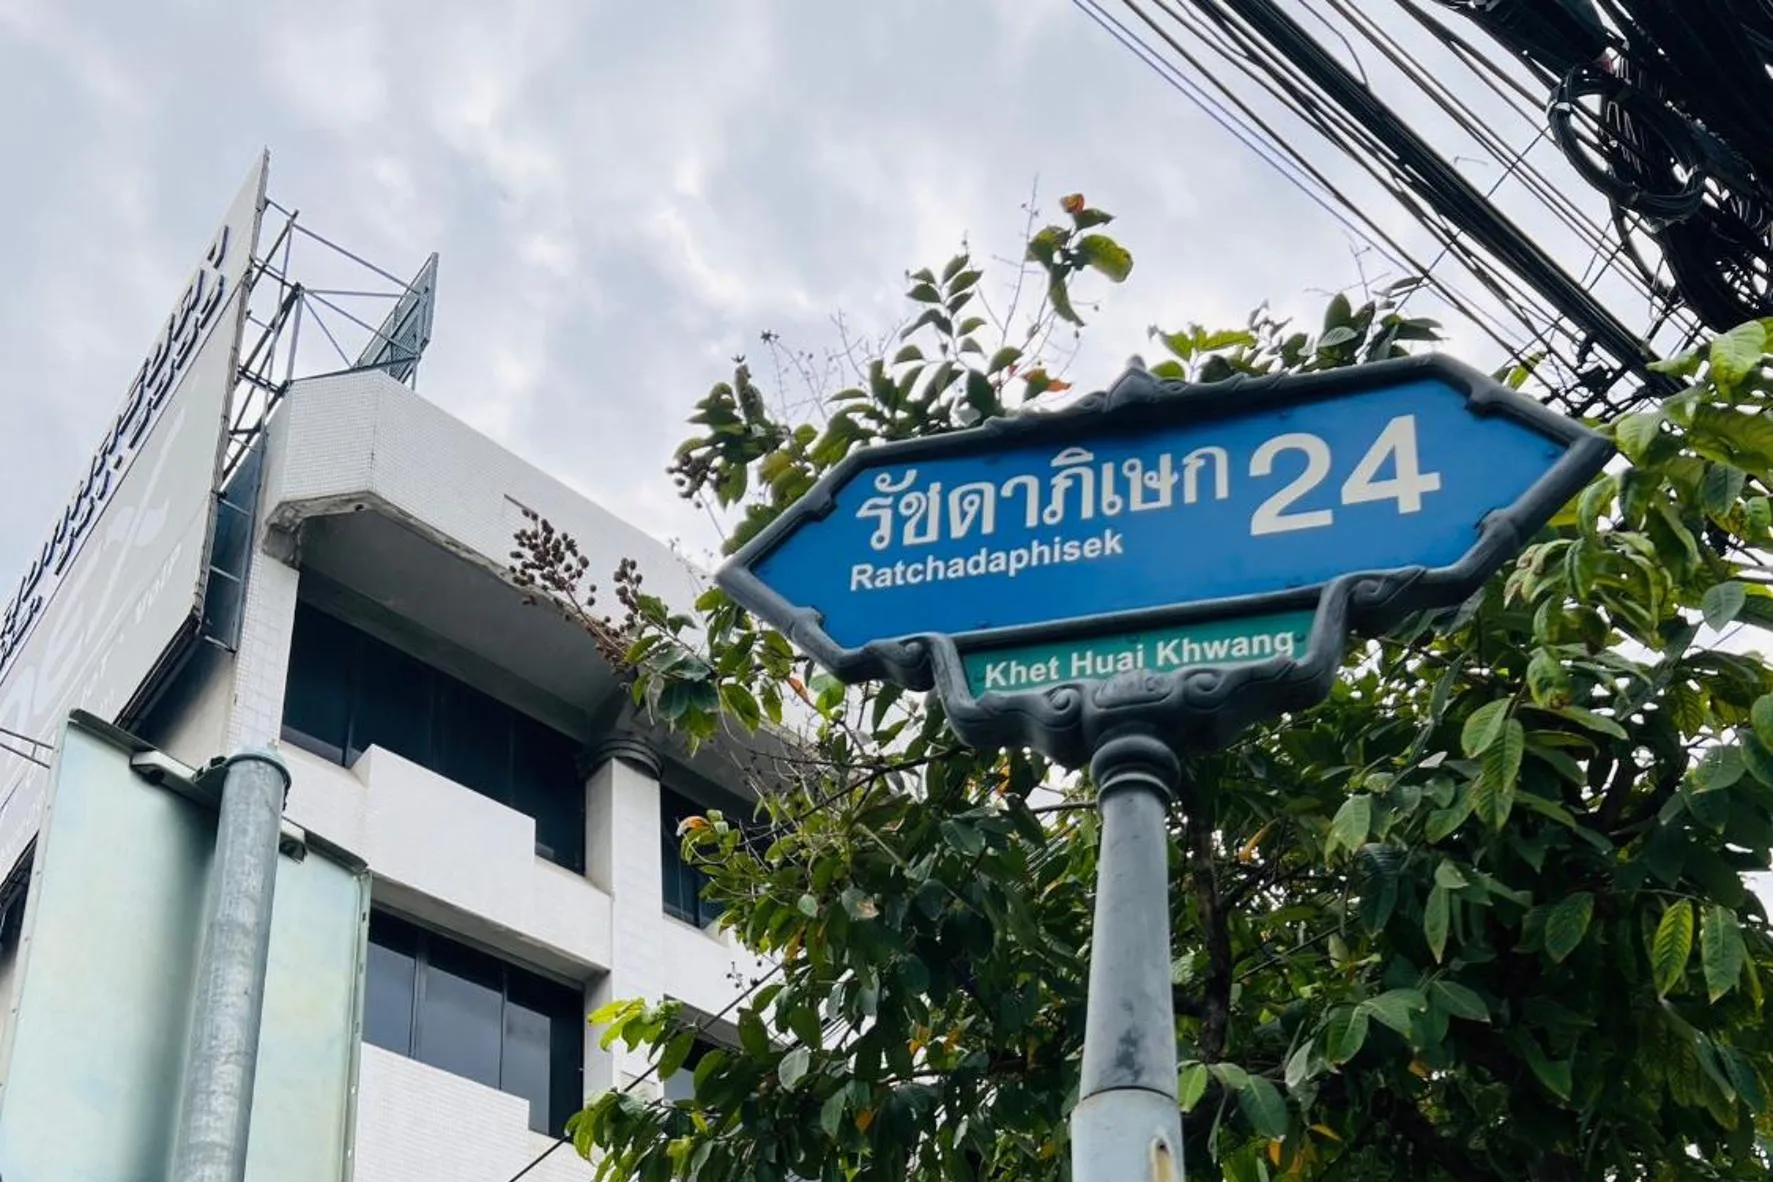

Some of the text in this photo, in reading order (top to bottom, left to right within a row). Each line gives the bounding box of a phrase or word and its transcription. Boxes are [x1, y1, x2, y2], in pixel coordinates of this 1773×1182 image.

[856, 413, 1441, 552] รัชดาภิเษก 24
[850, 529, 1124, 592] Ratchadaphisek
[984, 631, 1296, 688] Khet Huai Khwang
